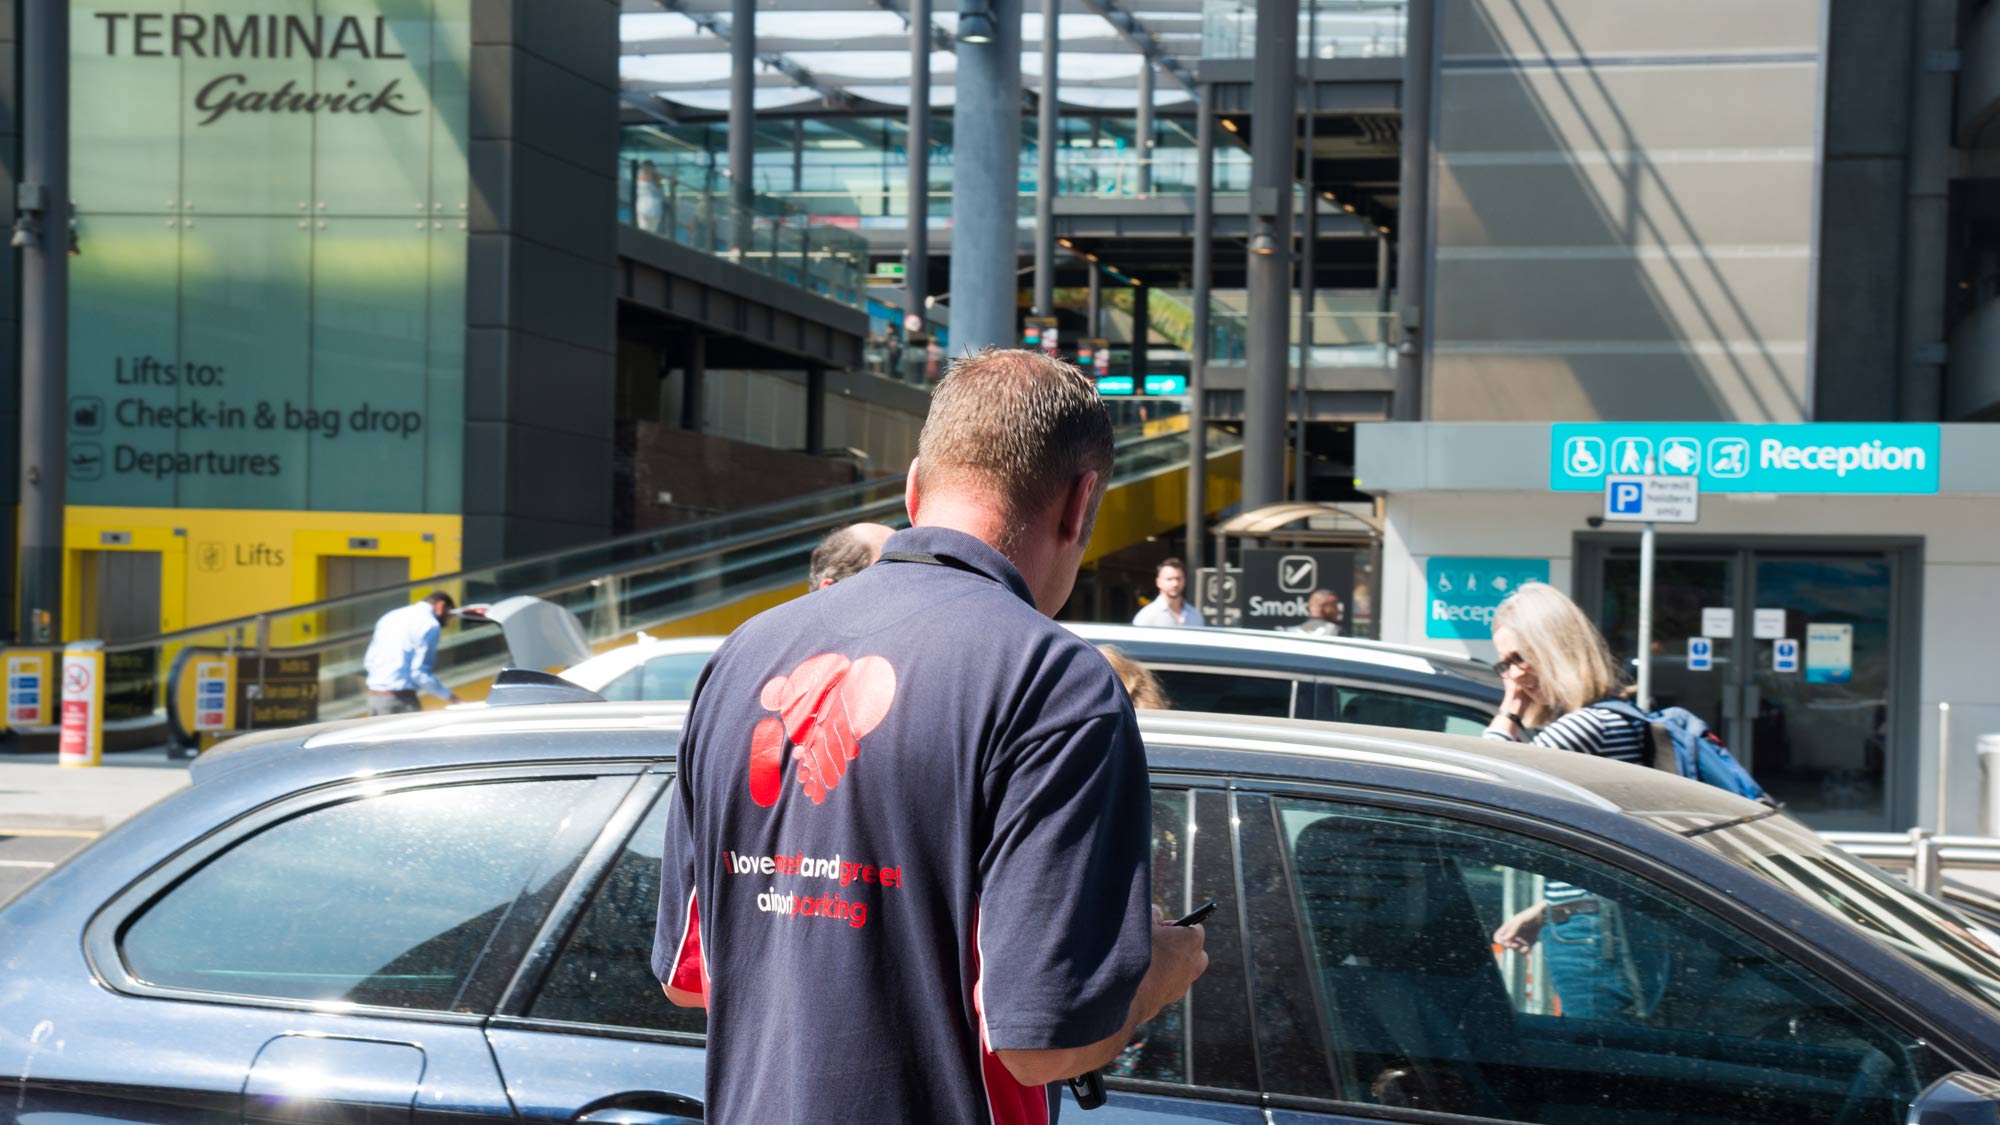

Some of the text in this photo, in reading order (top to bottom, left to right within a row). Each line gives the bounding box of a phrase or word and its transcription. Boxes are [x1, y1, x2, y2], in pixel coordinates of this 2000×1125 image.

[94, 12, 406, 60] TERMINAL
[194, 73, 424, 127] Gatwick
[115, 356, 225, 386] Lifts to:
[115, 398, 422, 440] Check-in & bag drop
[114, 444, 281, 480] Departures
[1760, 439, 1926, 477] Reception
[1617, 485, 1639, 511] P
[235, 541, 285, 567] Lifts
[1431, 599, 1496, 626] Recep
